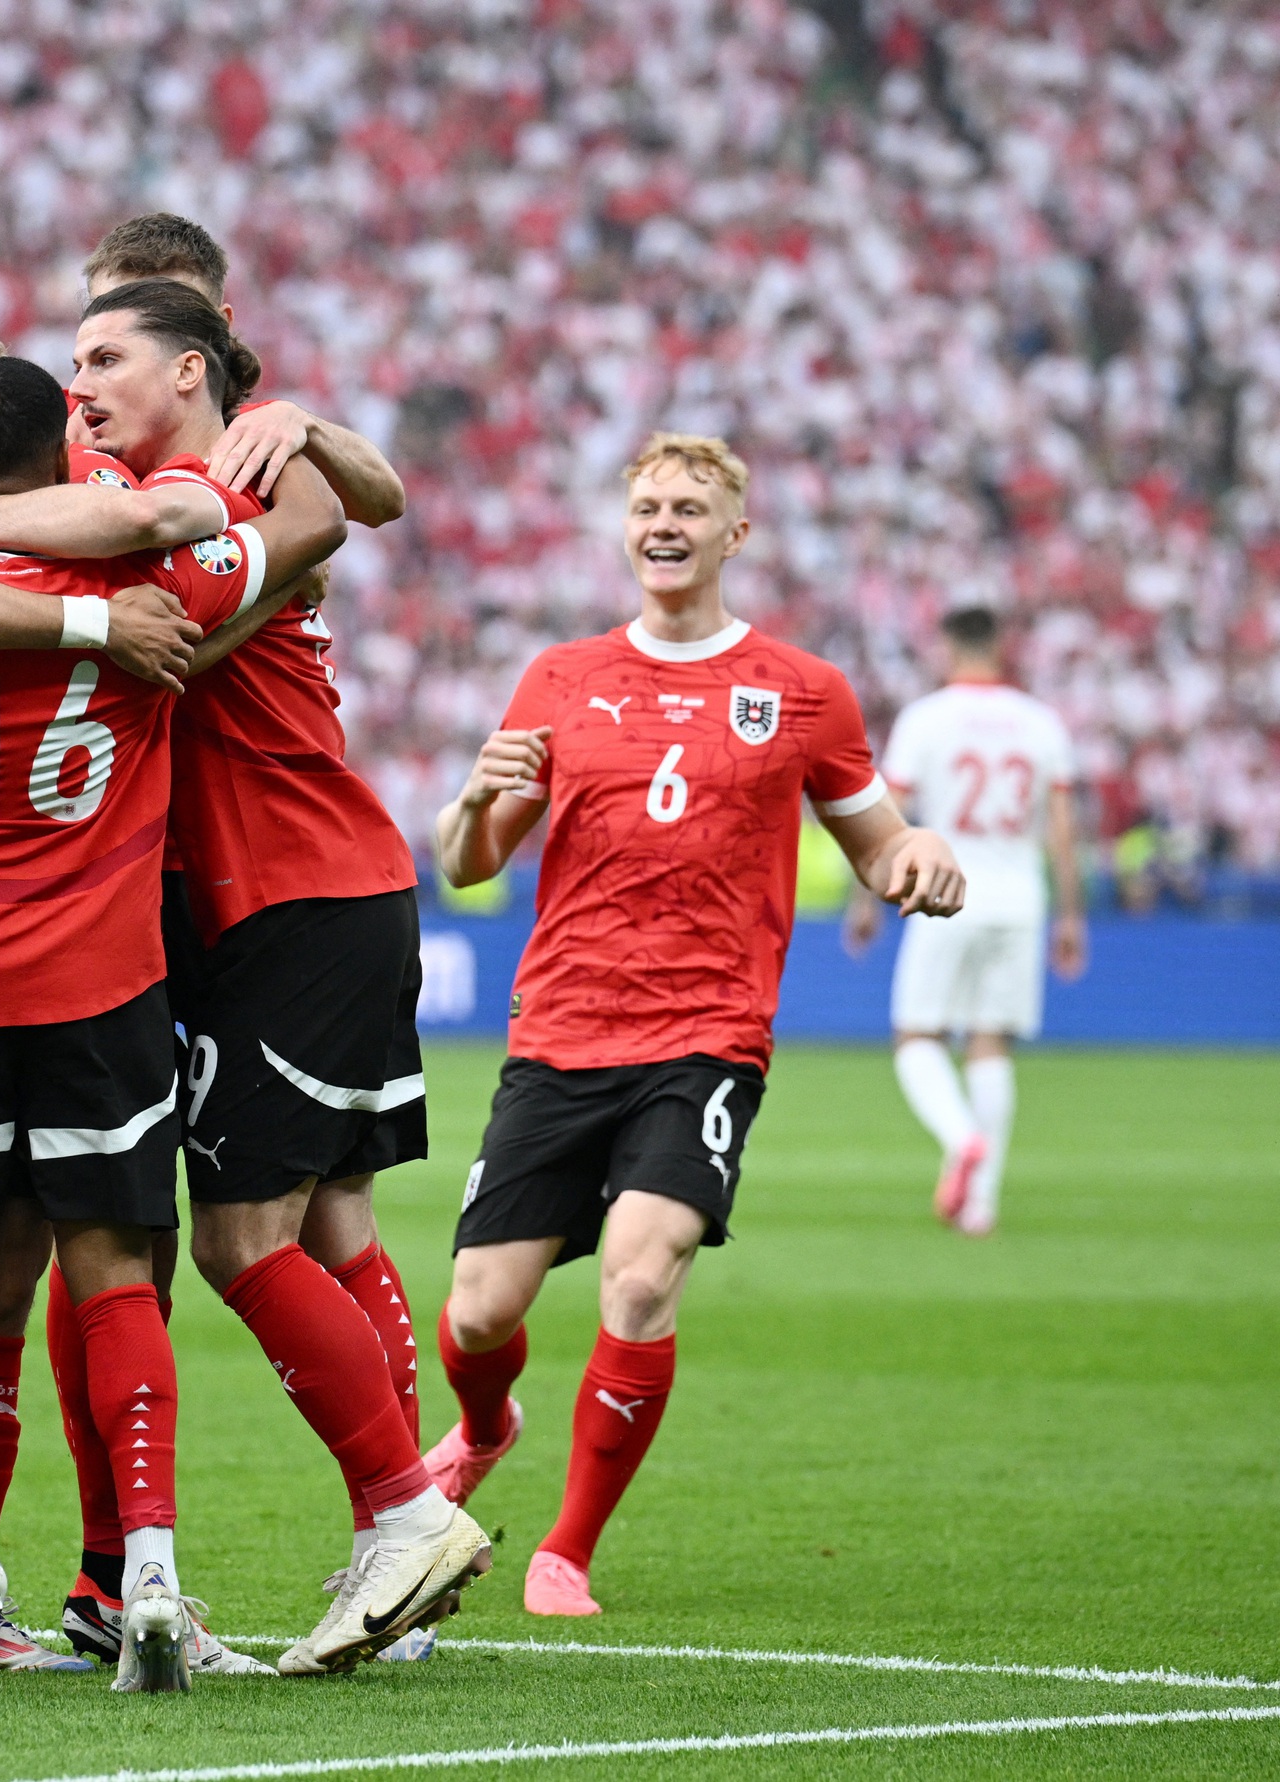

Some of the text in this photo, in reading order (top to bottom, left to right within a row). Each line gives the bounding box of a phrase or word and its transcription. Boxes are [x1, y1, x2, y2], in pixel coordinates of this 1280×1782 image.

[646, 743, 688, 823] 6
[950, 750, 1036, 839] 23
[187, 1034, 218, 1127] 9
[701, 1077, 736, 1154] 6
